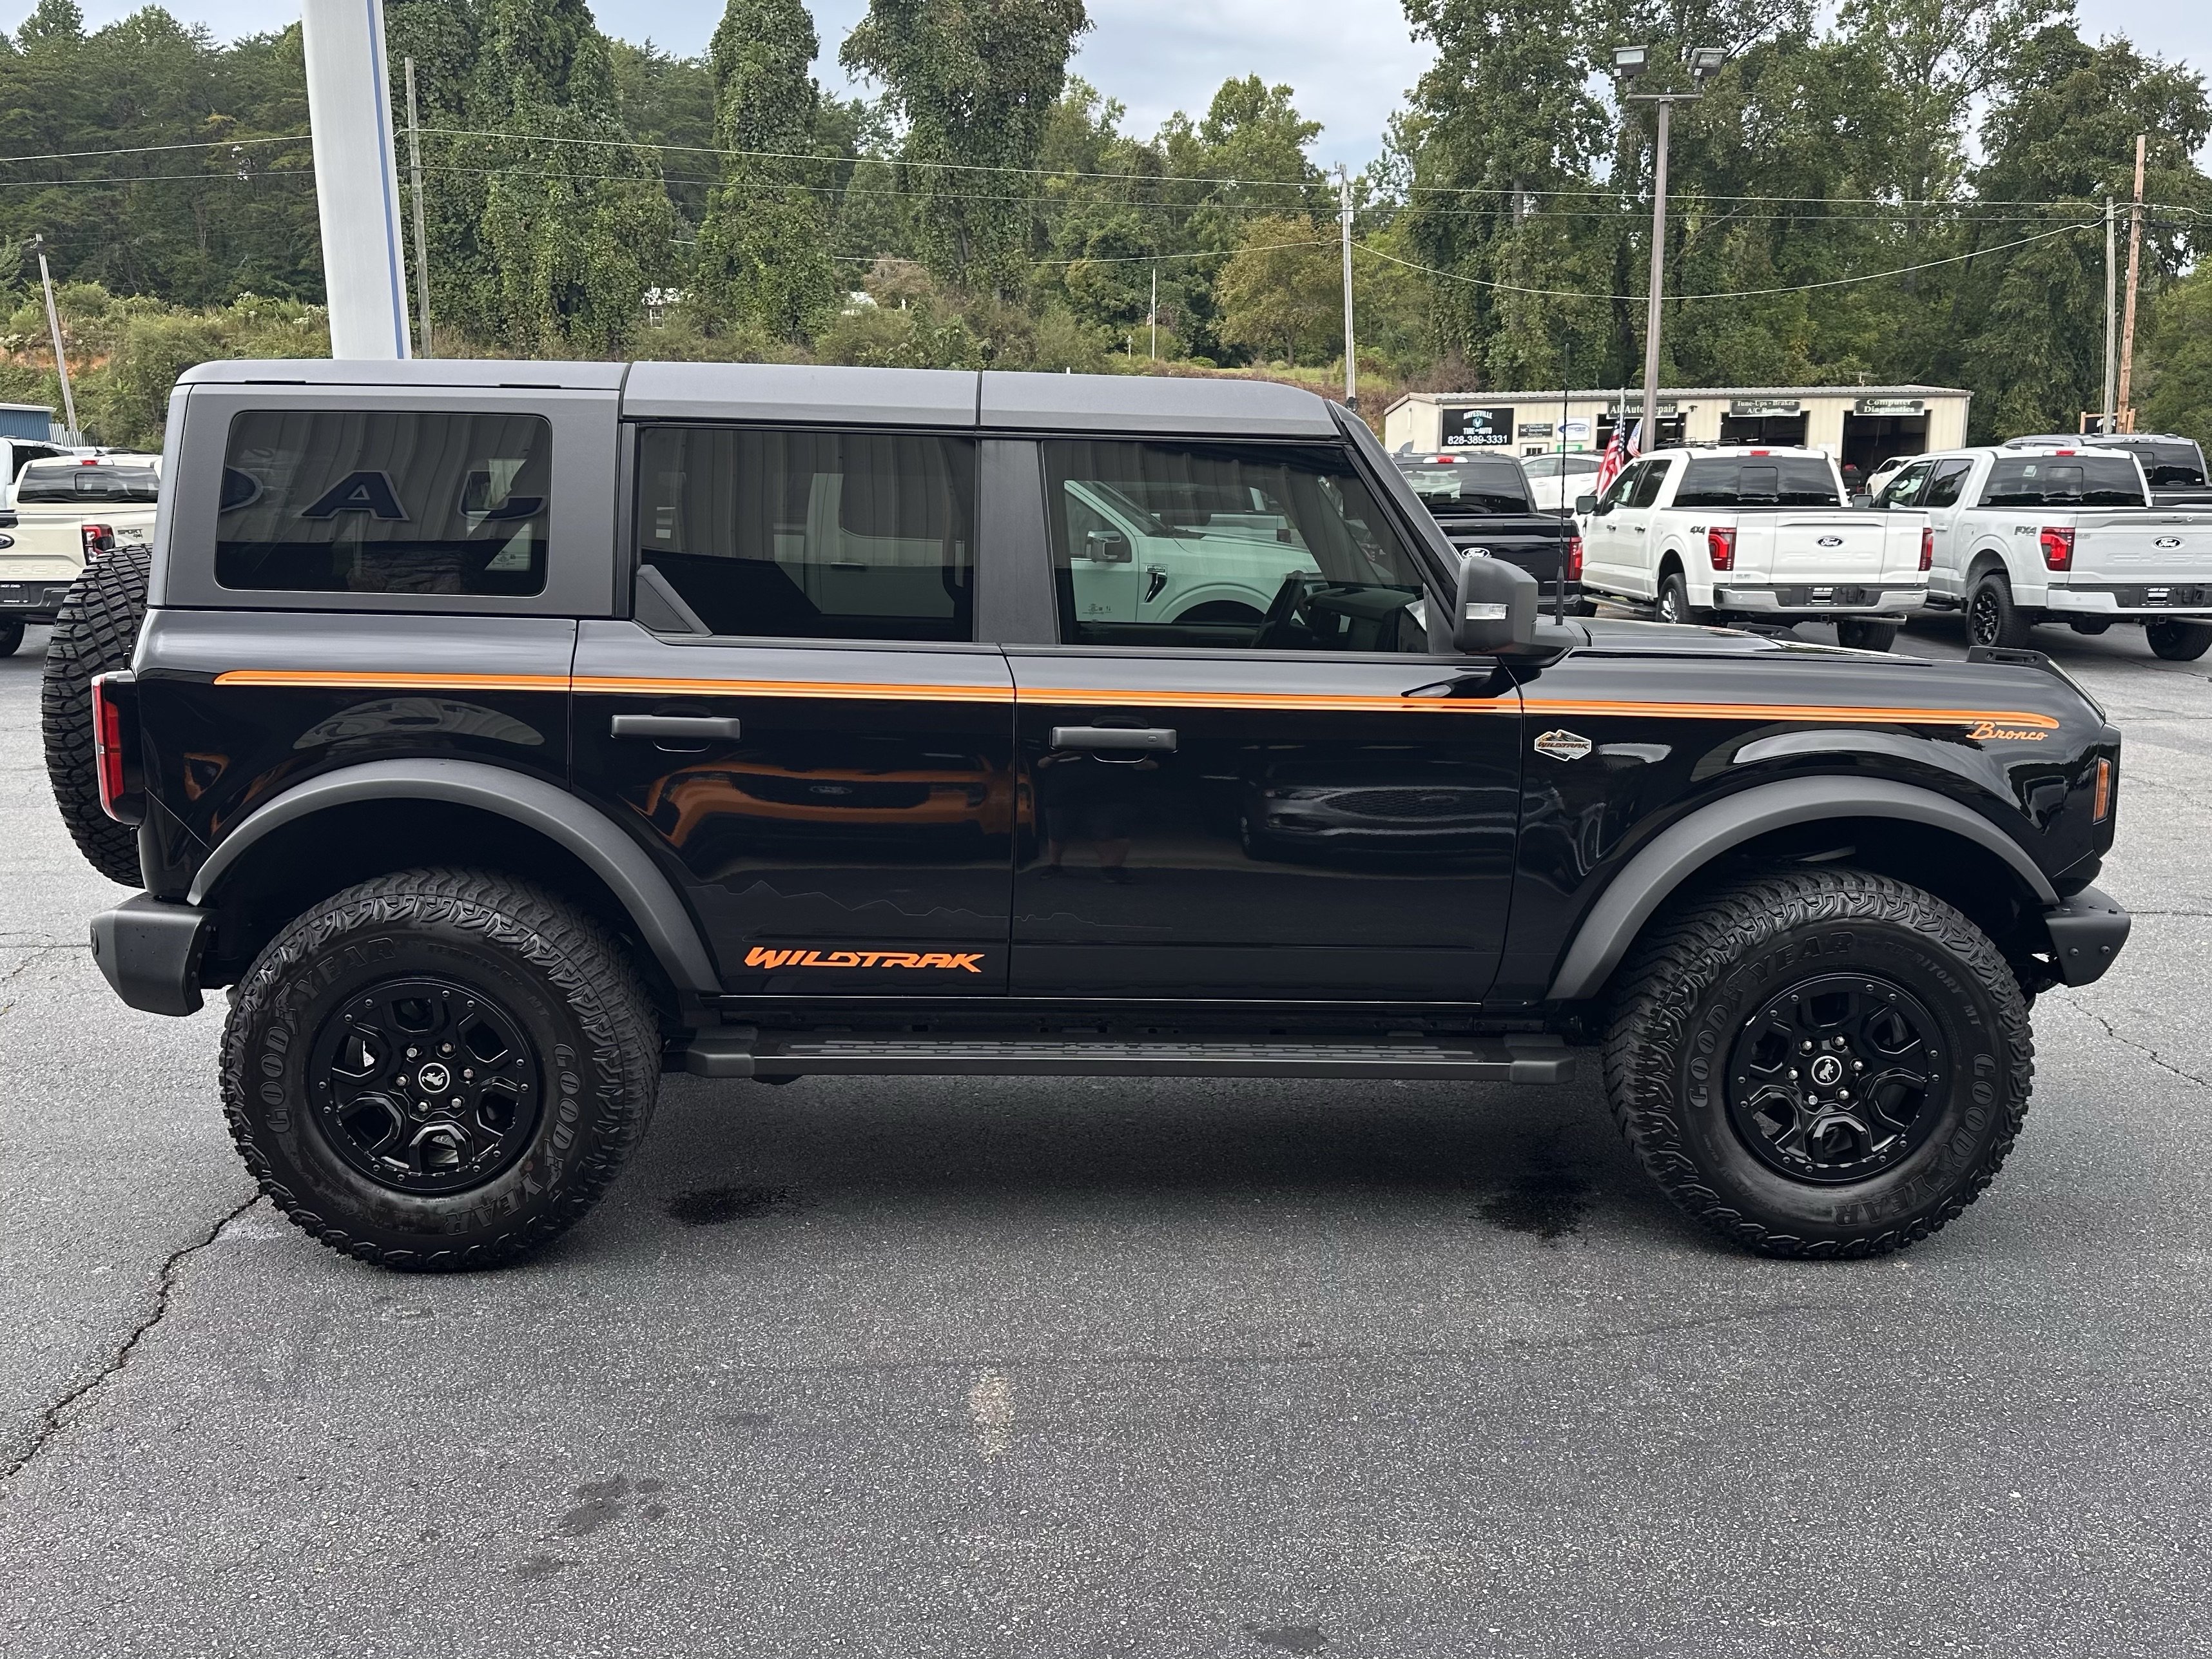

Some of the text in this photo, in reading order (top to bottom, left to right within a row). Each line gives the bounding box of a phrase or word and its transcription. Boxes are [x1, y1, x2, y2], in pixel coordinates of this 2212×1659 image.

[1463, 410, 1493, 420] HAYESVILLE
[1624, 405, 1644, 414] Auto
[1864, 405, 1915, 414] Diagnostics
[1448, 434, 1508, 445] 828-389-3331
[1966, 721, 2049, 741] Bronco
[744, 947, 985, 973] WILDTRAK
[1963, 1004, 1982, 1026] MT
